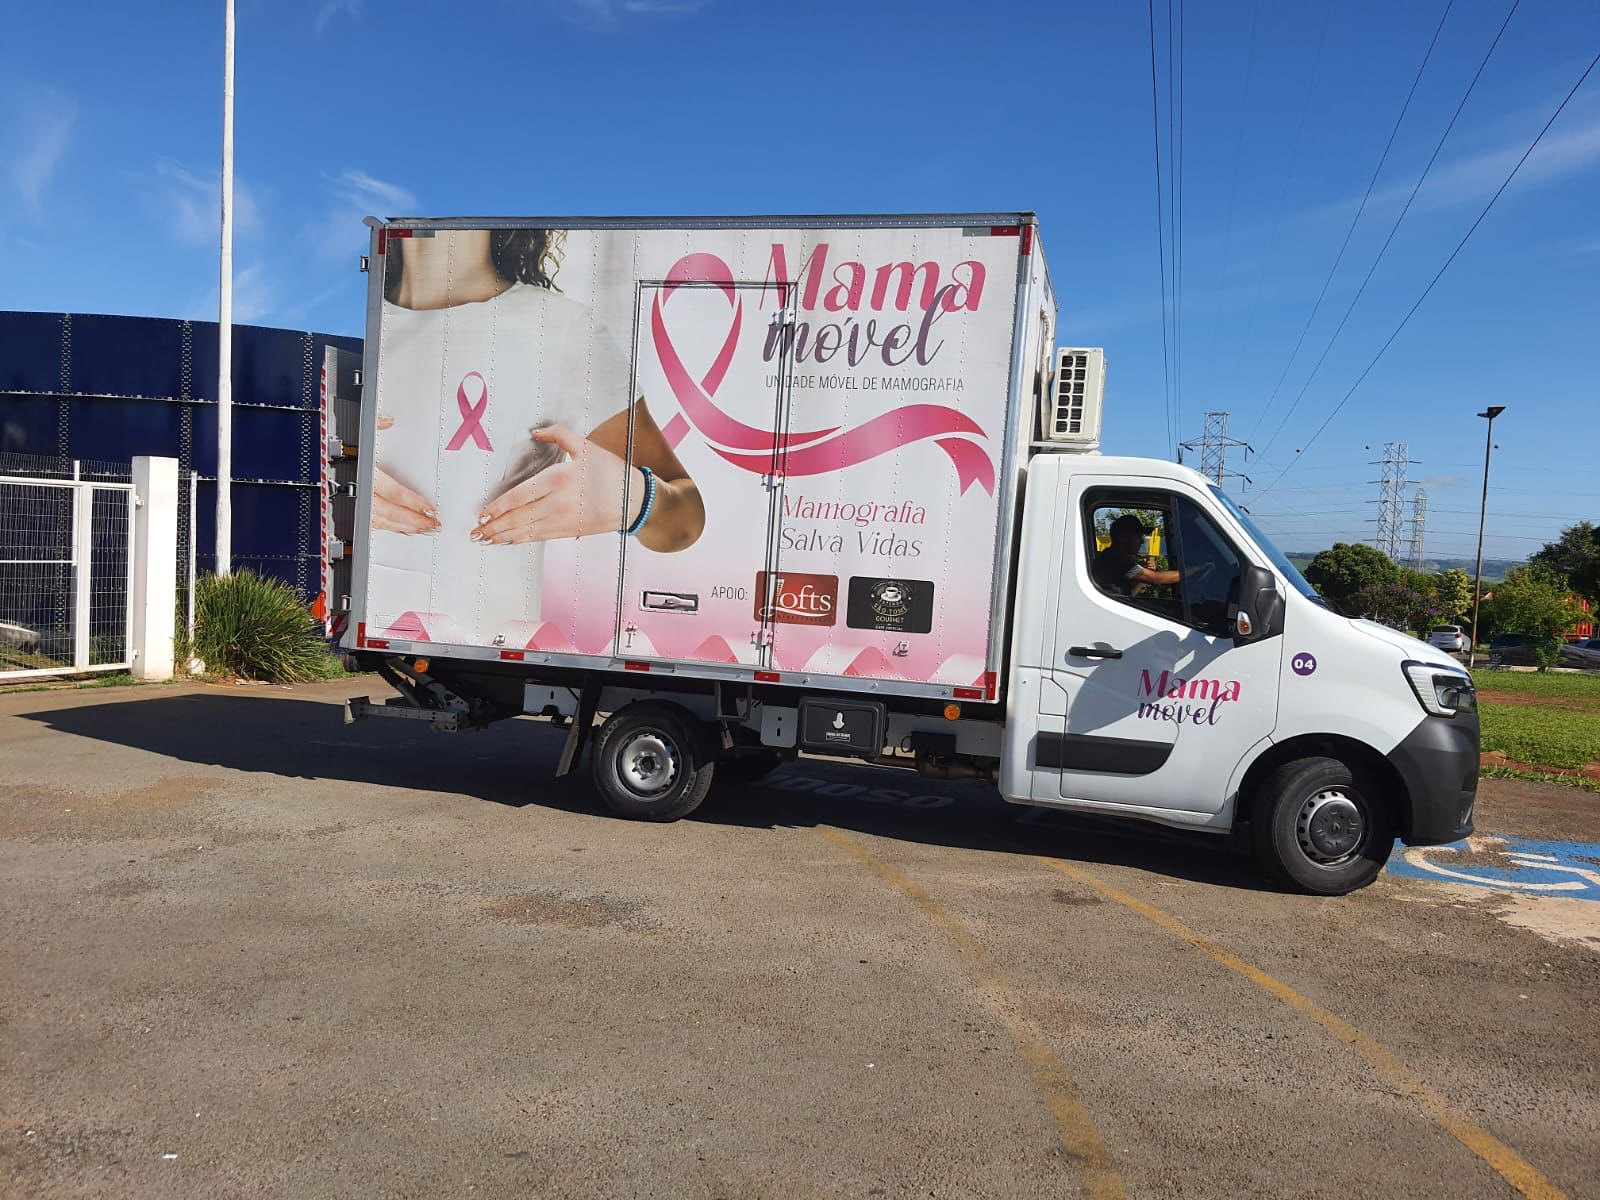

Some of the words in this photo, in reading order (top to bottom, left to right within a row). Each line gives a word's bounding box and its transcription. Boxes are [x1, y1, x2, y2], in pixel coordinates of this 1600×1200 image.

[759, 243, 986, 313] Mama
[763, 284, 957, 367] móvel
[765, 375, 815, 389] UNDADE
[818, 373, 859, 390] MÓVEL
[863, 376, 878, 390] DE
[882, 376, 964, 391] MAMOGRAFIA
[783, 495, 926, 527] Mamografia
[780, 527, 843, 553] Salva
[857, 530, 923, 557] Vidas
[711, 586, 748, 601] APOIO:
[1294, 658, 1314, 670] 04
[1136, 669, 1241, 702] Mama
[1137, 690, 1227, 725] móvel
